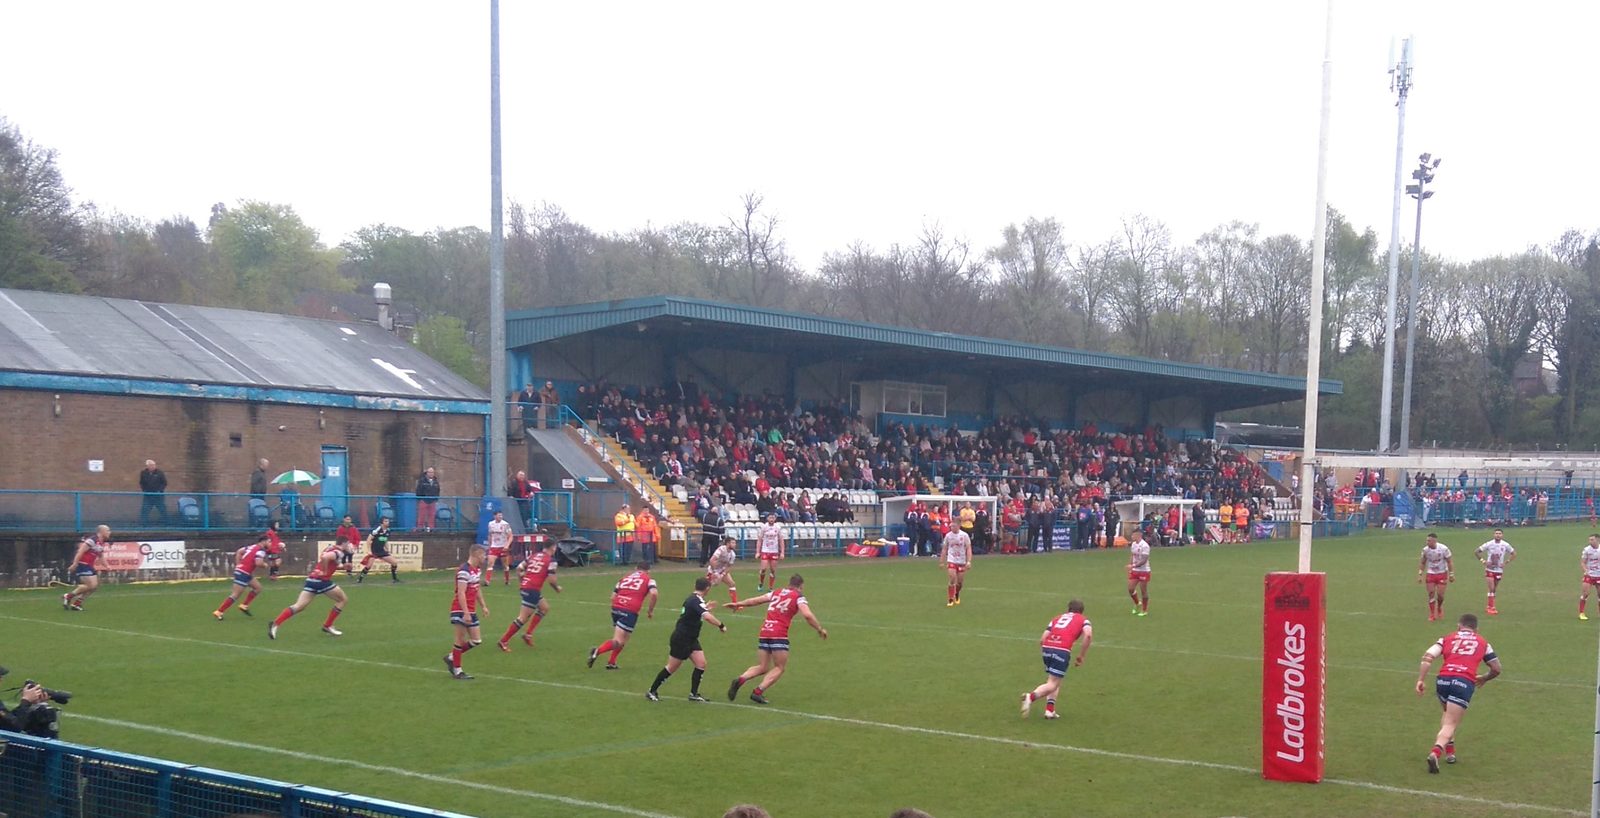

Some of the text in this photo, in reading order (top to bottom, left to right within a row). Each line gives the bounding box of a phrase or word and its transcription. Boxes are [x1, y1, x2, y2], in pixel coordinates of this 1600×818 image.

[526, 559, 545, 574] 25
[619, 577, 645, 591] 23
[767, 595, 792, 613] 24
[1054, 615, 1073, 629] 9
[1450, 639, 1479, 655] 13
[1276, 621, 1306, 763] Ladbrokes
